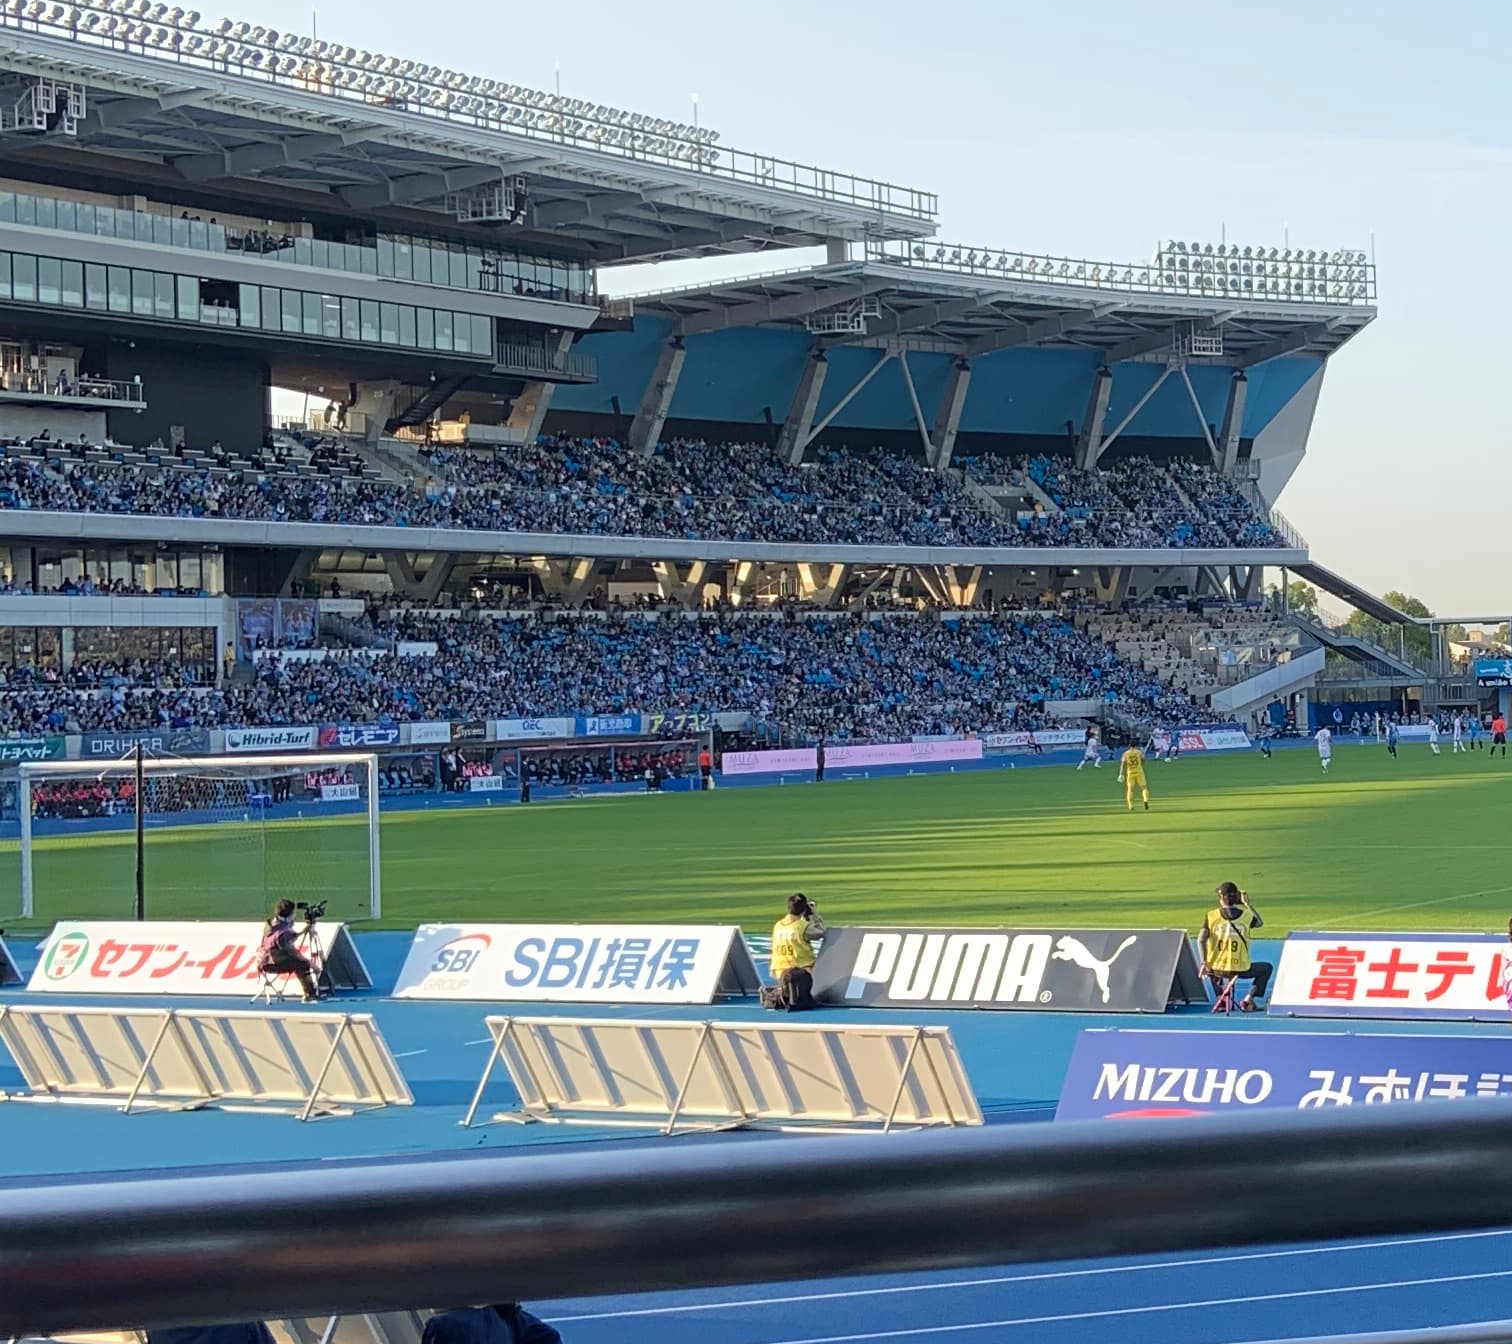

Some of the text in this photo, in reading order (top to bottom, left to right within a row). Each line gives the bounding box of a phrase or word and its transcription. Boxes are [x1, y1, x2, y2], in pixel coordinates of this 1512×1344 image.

[242, 731, 311, 746] Hibrid-Turf
[90, 938, 308, 981] セブン-イレ
[431, 948, 479, 974] SBI
[504, 936, 701, 991] SBI損保
[844, 933, 1053, 1003] PUMA
[1092, 1062, 1273, 1105] MIZUHO
